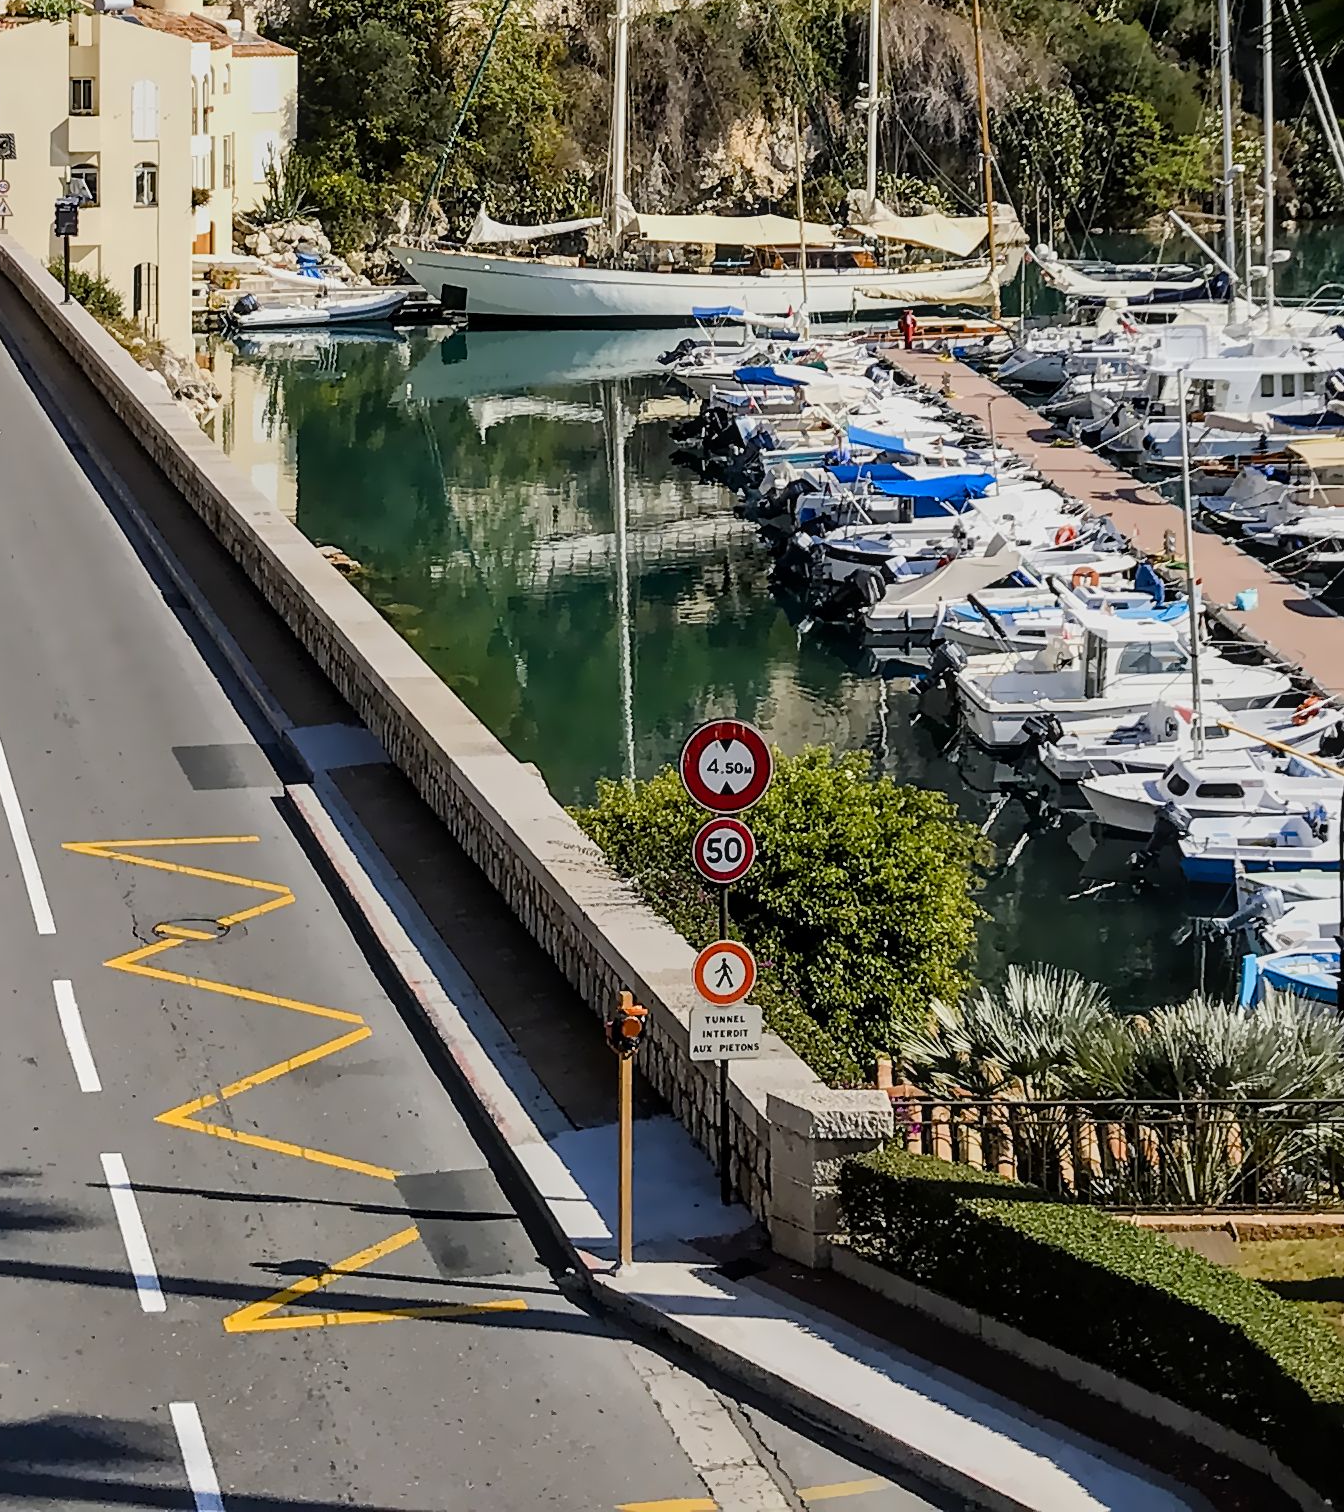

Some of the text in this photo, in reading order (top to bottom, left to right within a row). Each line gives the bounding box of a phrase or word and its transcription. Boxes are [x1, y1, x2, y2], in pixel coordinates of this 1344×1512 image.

[706, 837, 742, 863] 50
[704, 1015, 746, 1024] TUNNEL
[702, 1029, 748, 1038] INTERDIT
[693, 1043, 760, 1053] AUX PIETONS
